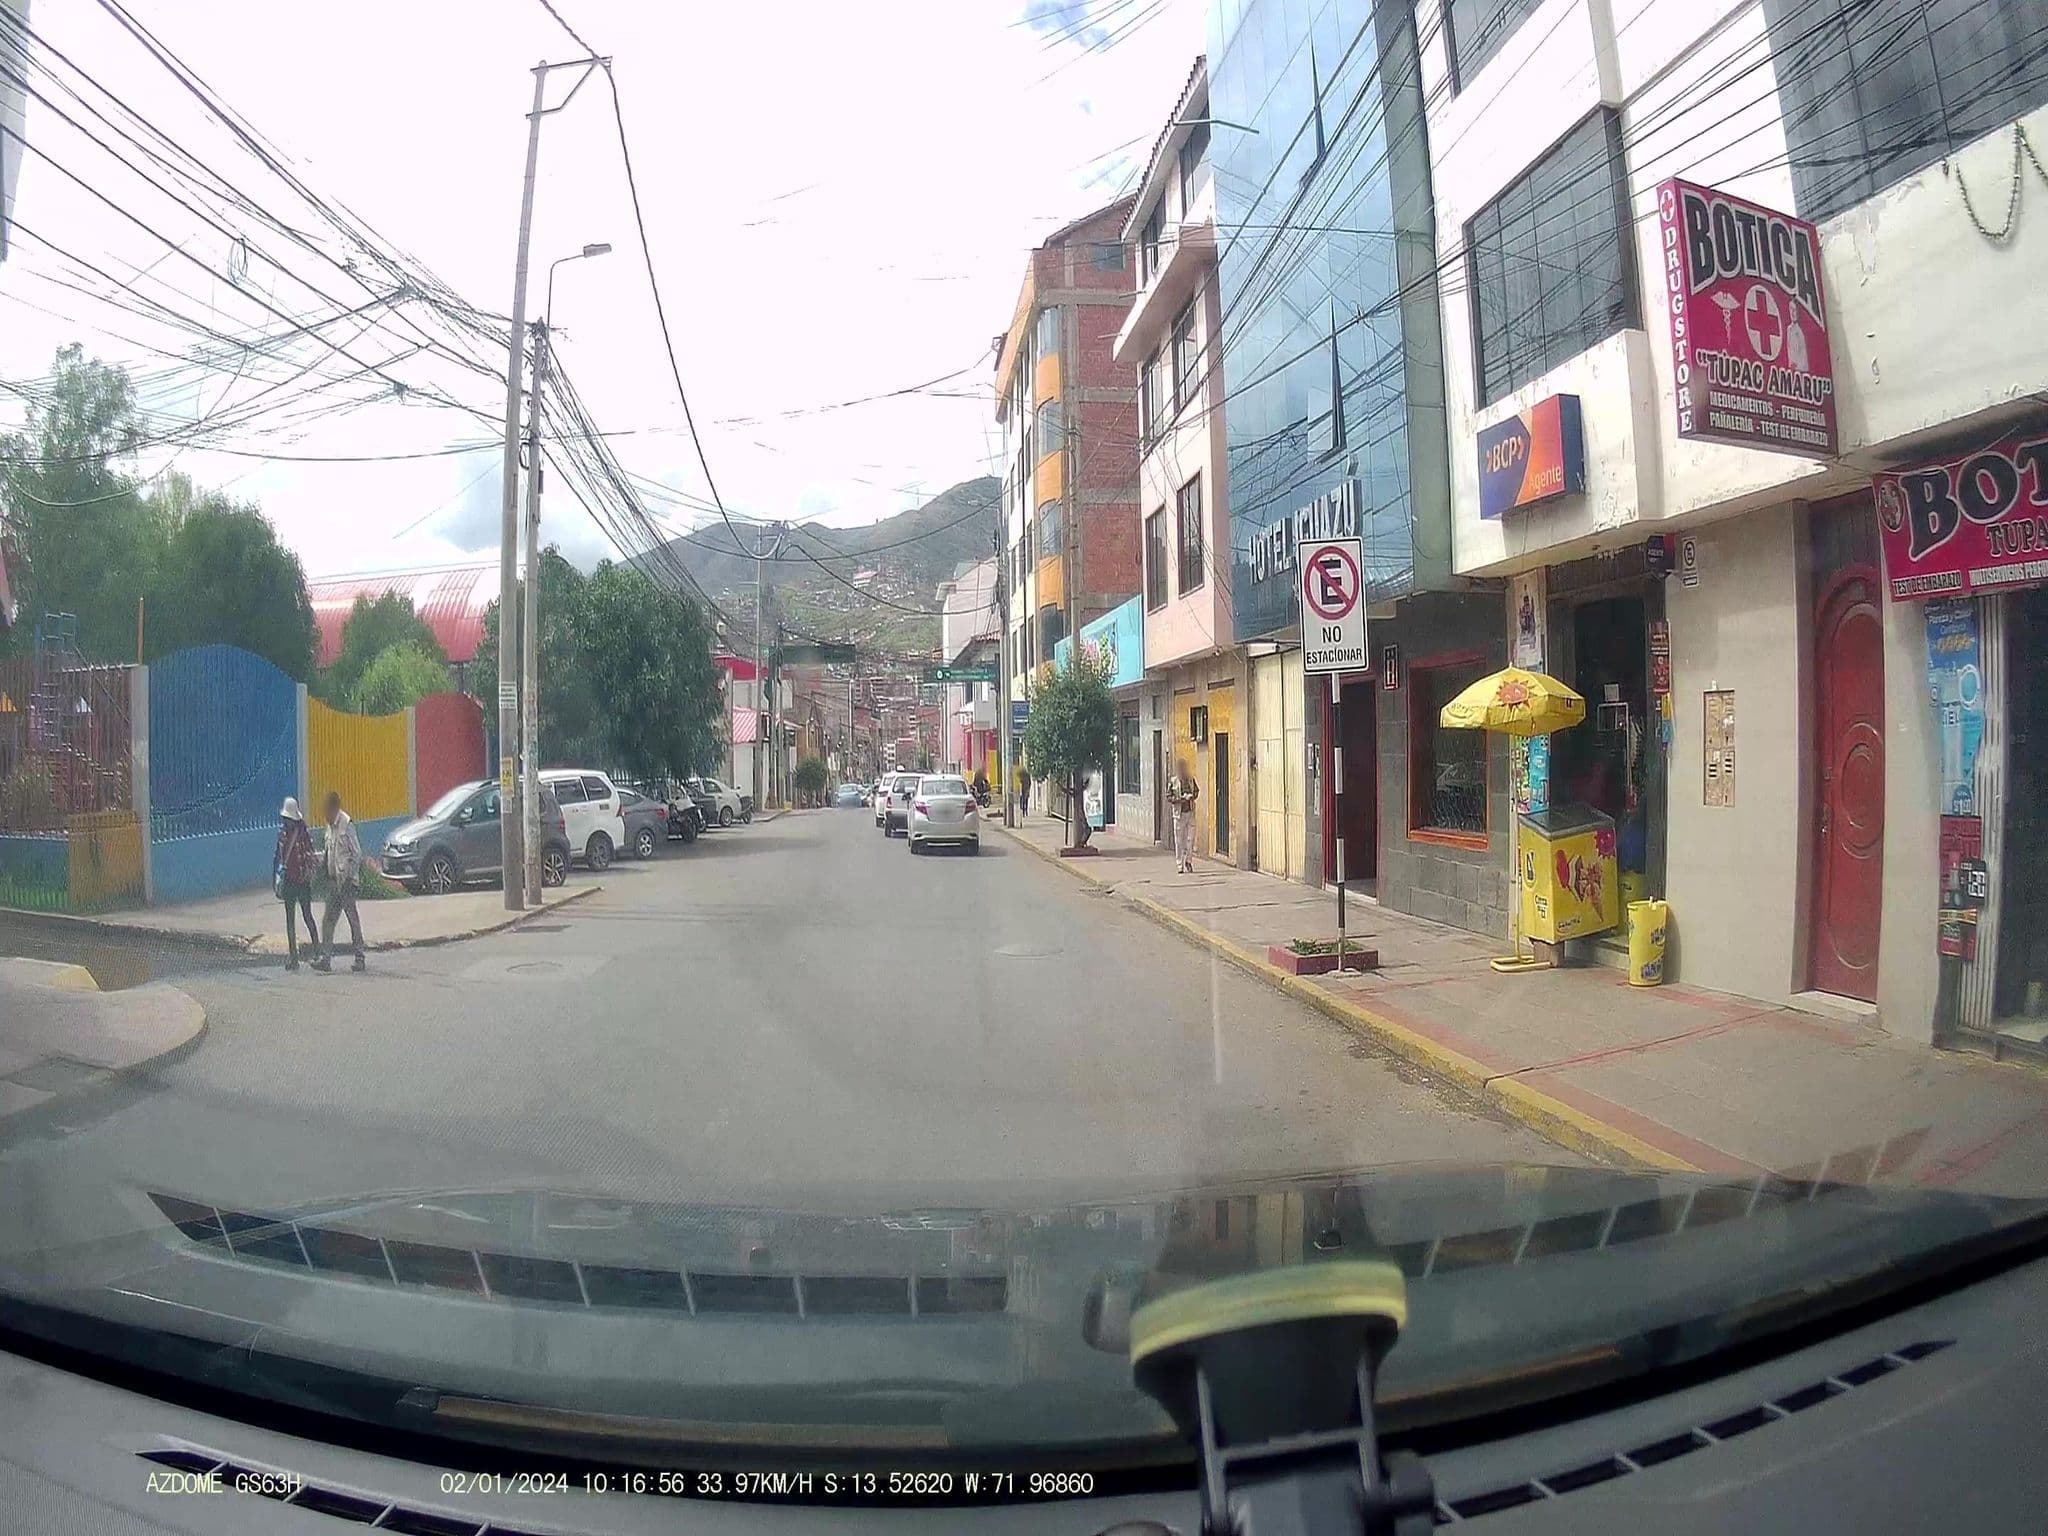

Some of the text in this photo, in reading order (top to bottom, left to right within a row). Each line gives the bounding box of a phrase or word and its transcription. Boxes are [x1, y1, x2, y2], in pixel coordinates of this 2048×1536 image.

[1681, 190, 1824, 329] BOTICA
[1664, 226, 1692, 433] DRUGSTORE
[1709, 391, 1774, 416] MEDICAMENTOS
[1760, 421, 1779, 437] TEST
[1492, 437, 1517, 473] BCP
[1529, 465, 1562, 494] Agente
[1249, 518, 1291, 585] HOTEL
[1322, 626, 1342, 643] NO
